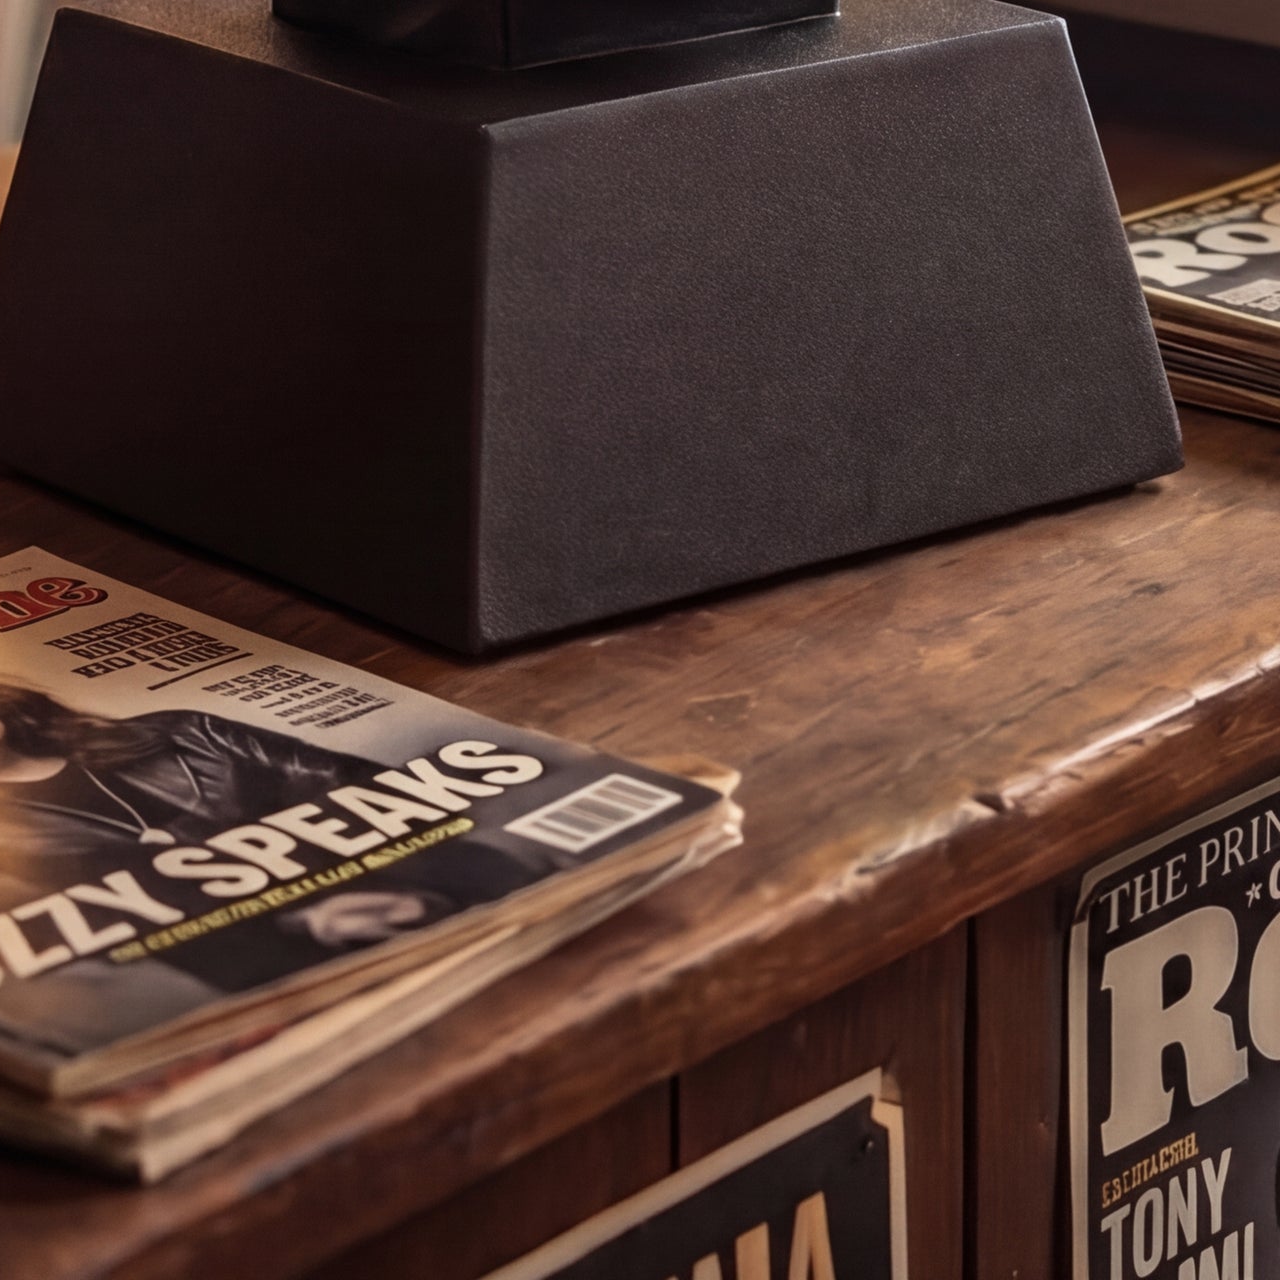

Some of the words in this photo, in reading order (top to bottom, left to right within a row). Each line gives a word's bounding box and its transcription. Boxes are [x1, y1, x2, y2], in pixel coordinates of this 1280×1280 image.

[151, 738, 545, 902] SPEAKS
[1099, 854, 1187, 934] THE
[1101, 1147, 1232, 1280] TONY
